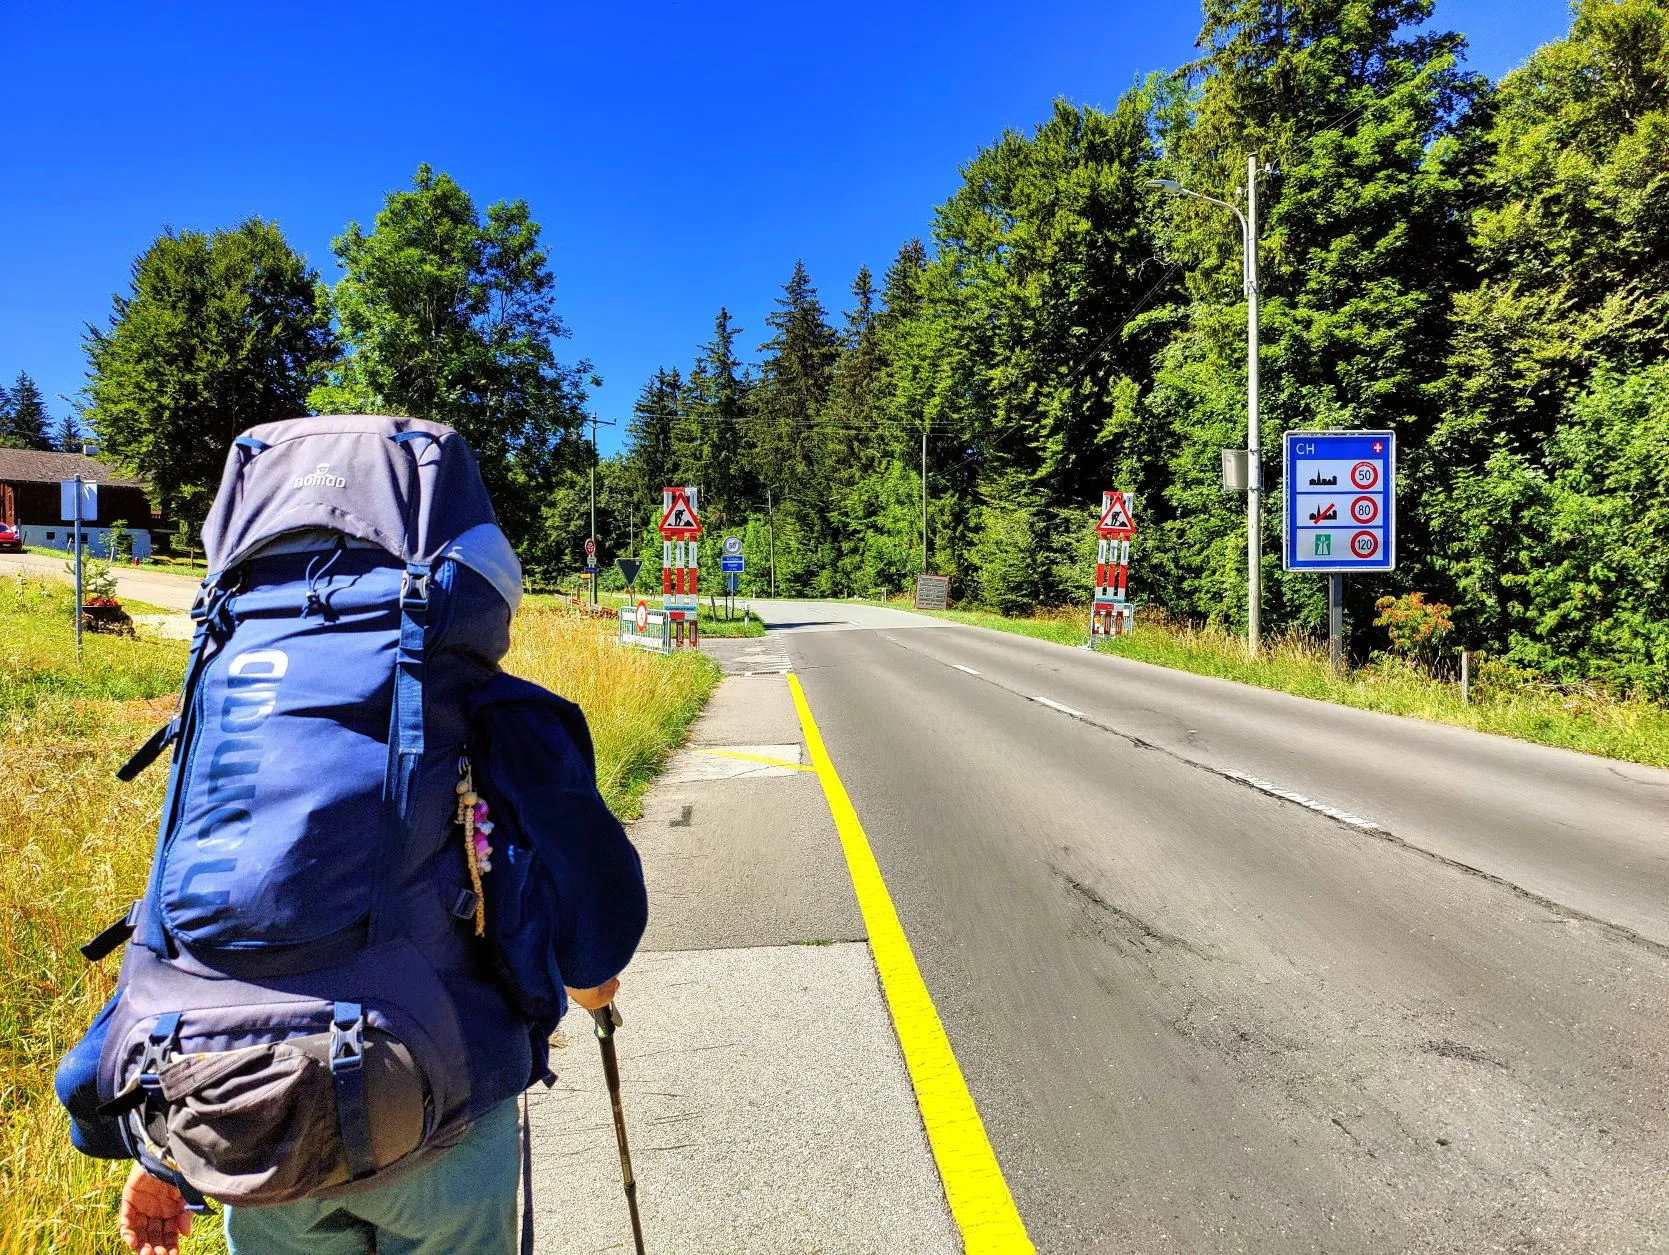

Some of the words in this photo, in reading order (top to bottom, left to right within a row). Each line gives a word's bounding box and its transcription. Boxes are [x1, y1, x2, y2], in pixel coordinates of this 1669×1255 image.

[1296, 444, 1315, 455] CH
[1358, 470, 1371, 481] 50
[1358, 504, 1371, 516] 80
[1357, 538, 1372, 550] 120
